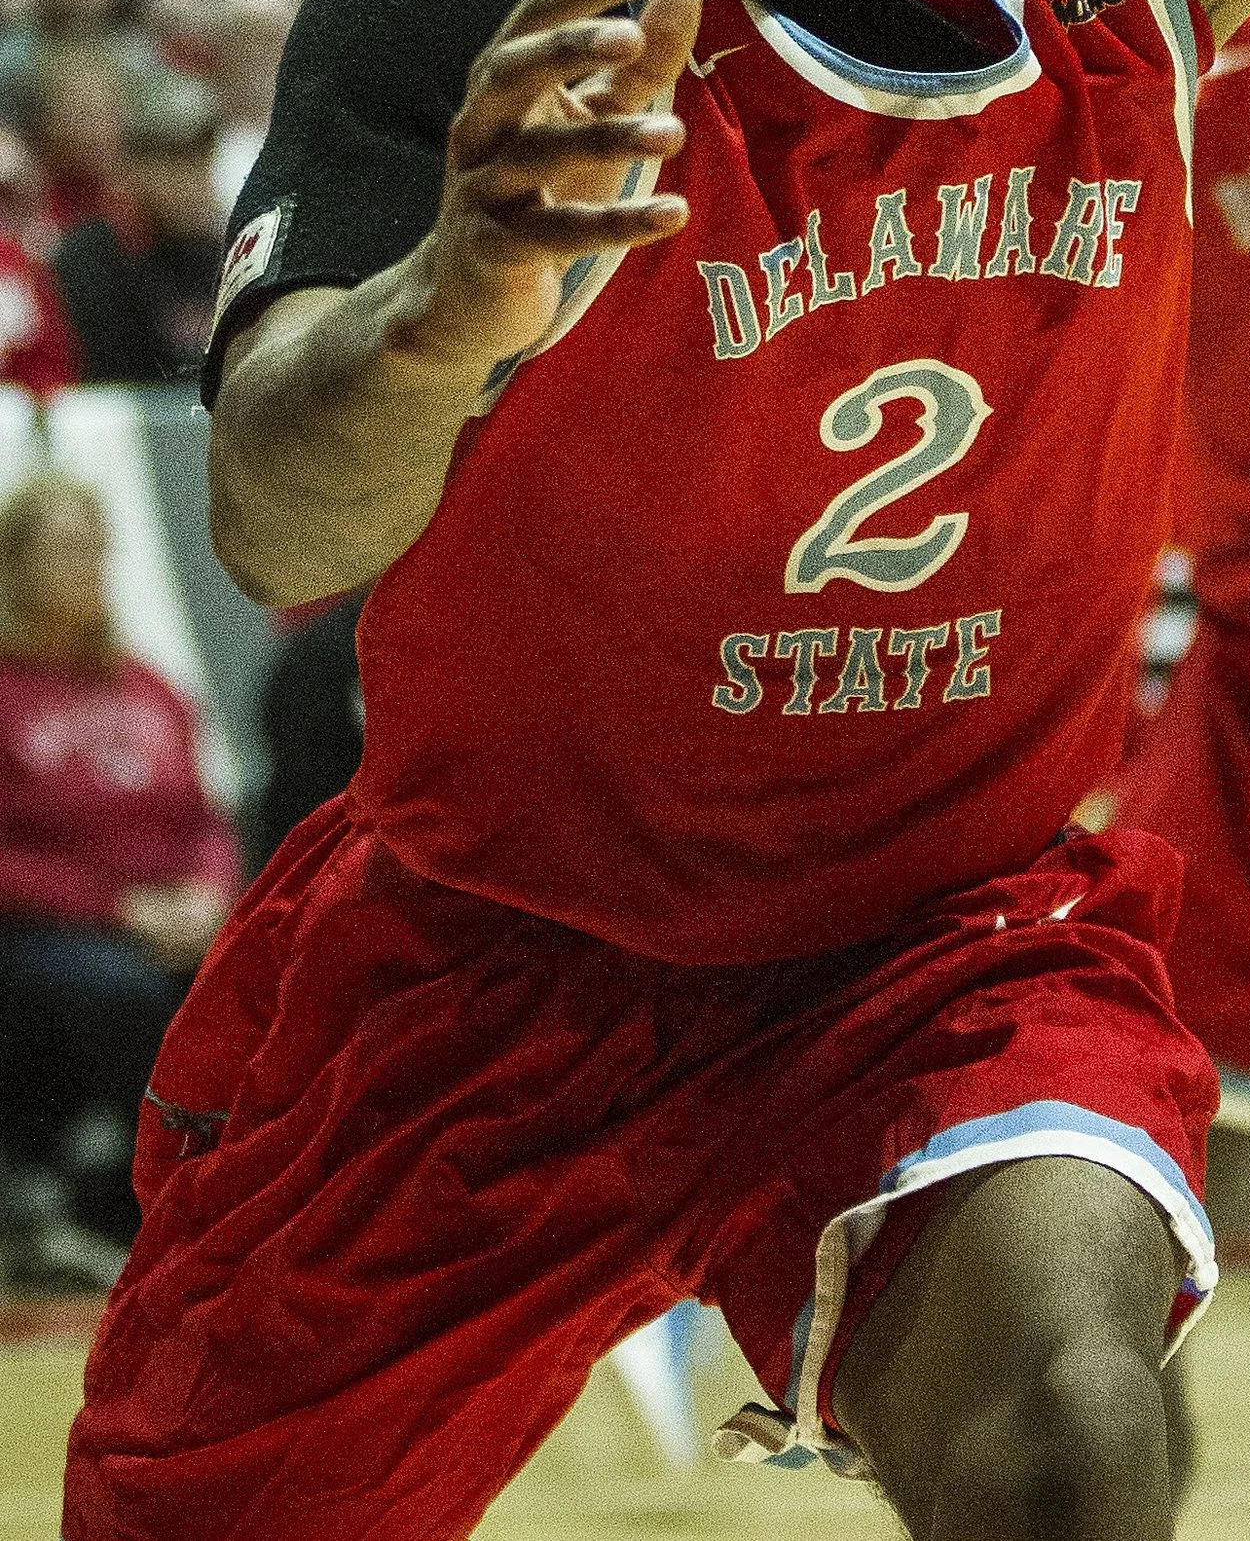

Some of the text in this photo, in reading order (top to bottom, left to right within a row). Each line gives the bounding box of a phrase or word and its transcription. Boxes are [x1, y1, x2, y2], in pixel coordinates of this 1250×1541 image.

[698, 166, 1143, 360] DELAWARE
[784, 358, 994, 595] 2
[711, 608, 1002, 716] STATE
